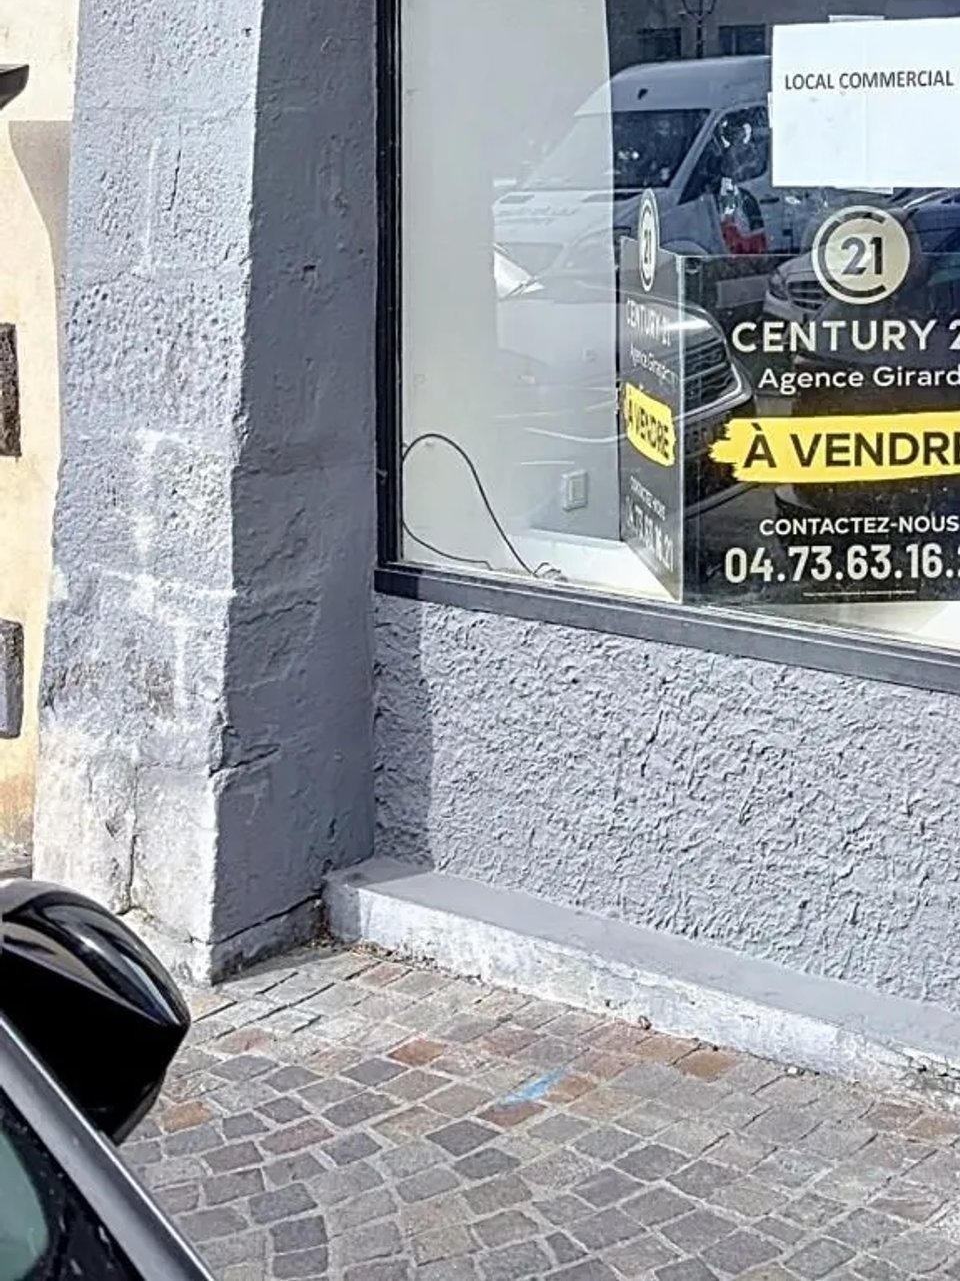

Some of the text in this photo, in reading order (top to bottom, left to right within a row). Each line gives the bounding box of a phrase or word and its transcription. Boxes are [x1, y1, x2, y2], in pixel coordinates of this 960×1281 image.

[785, 69, 954, 90] LOCAL COMMERCIAL
[840, 236, 884, 276] 21
[732, 319, 937, 353] CENTURY
[758, 368, 864, 395] Agence
[743, 422, 777, 468] À
[759, 515, 960, 537] CONTACTEZ-NOUS
